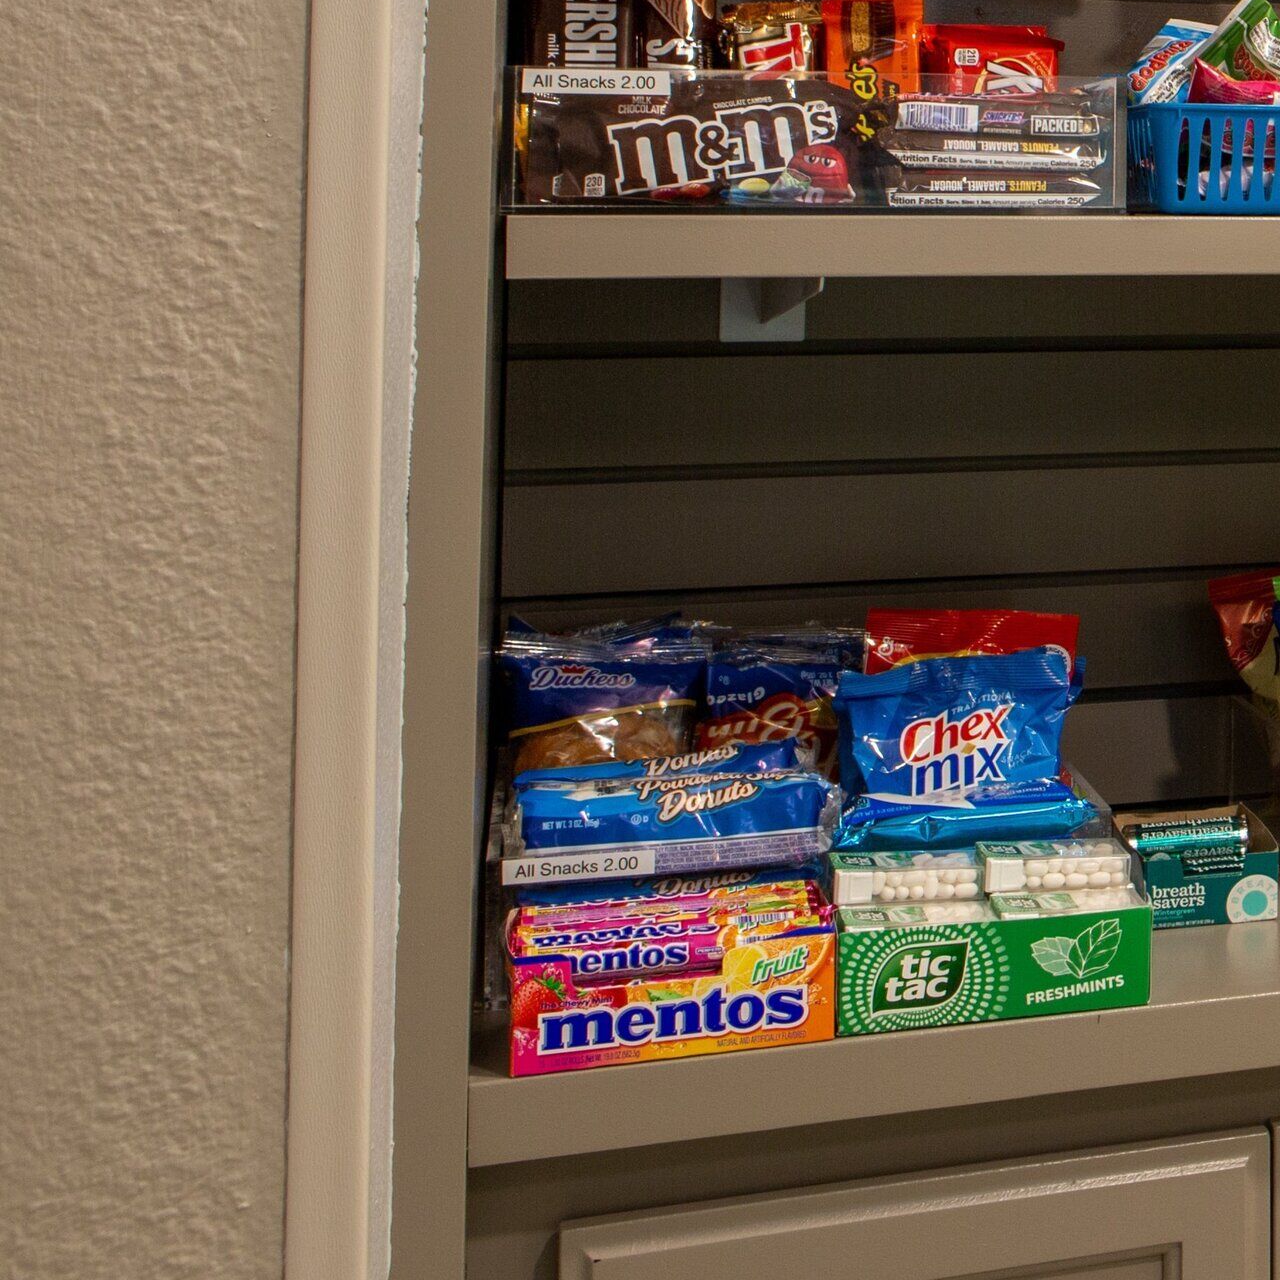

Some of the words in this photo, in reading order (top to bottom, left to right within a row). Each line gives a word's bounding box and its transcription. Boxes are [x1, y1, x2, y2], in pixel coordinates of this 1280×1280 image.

[533, 75, 553, 88] All
[559, 74, 616, 89] Snacks
[621, 76, 656, 90] 2.00
[618, 104, 666, 115] CHOCOLATE
[984, 111, 1023, 121] SNICKERS
[1034, 119, 1077, 133] PACKED
[944, 139, 976, 151] NOUGAT
[932, 155, 957, 163] Facts
[586, 176, 602, 187] 230
[930, 180, 963, 192] NOUGAT
[1067, 197, 1084, 205] 250
[529, 669, 635, 690] Duchess
[903, 706, 1015, 763] Chex
[916, 743, 1004, 796] mix
[657, 782, 759, 823] Donuts
[515, 864, 536, 879] All
[540, 859, 599, 877] Snacks
[603, 857, 639, 872] 2.00
[1152, 883, 1206, 899] breath
[1152, 895, 1205, 909] savers
[1154, 908, 1195, 916] Wintergreen
[751, 944, 809, 985] fruit
[900, 950, 951, 980] tic
[885, 976, 948, 1002] tac
[1025, 974, 1124, 1006] FRESHMINTS
[537, 985, 809, 1055] mentos
